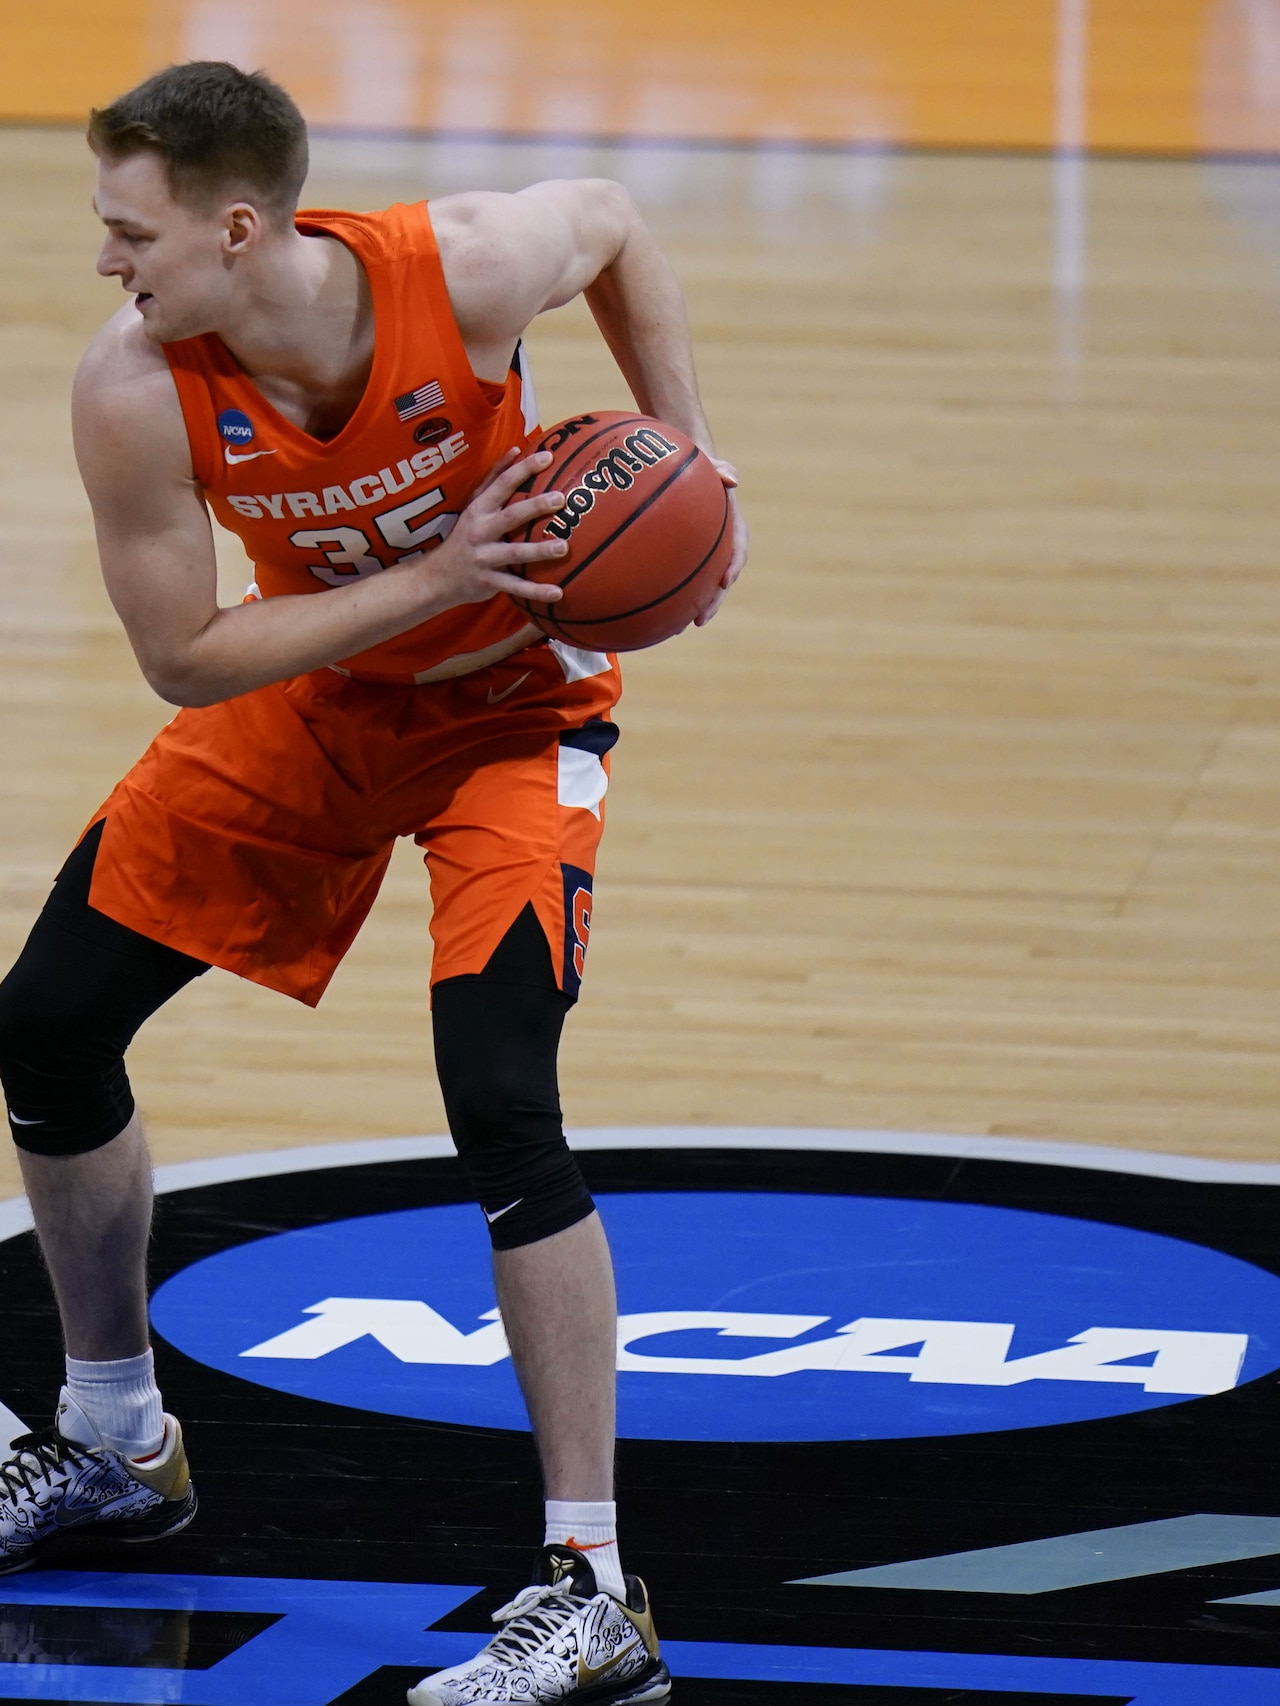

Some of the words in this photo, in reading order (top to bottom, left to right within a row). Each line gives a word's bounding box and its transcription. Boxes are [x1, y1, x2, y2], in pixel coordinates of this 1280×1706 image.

[222, 424, 253, 438] NCAA
[226, 430, 470, 520] SYRACUSE
[543, 427, 680, 541] Wilson
[289, 487, 462, 587] 35
[238, 1297, 1250, 1395] NCAA
